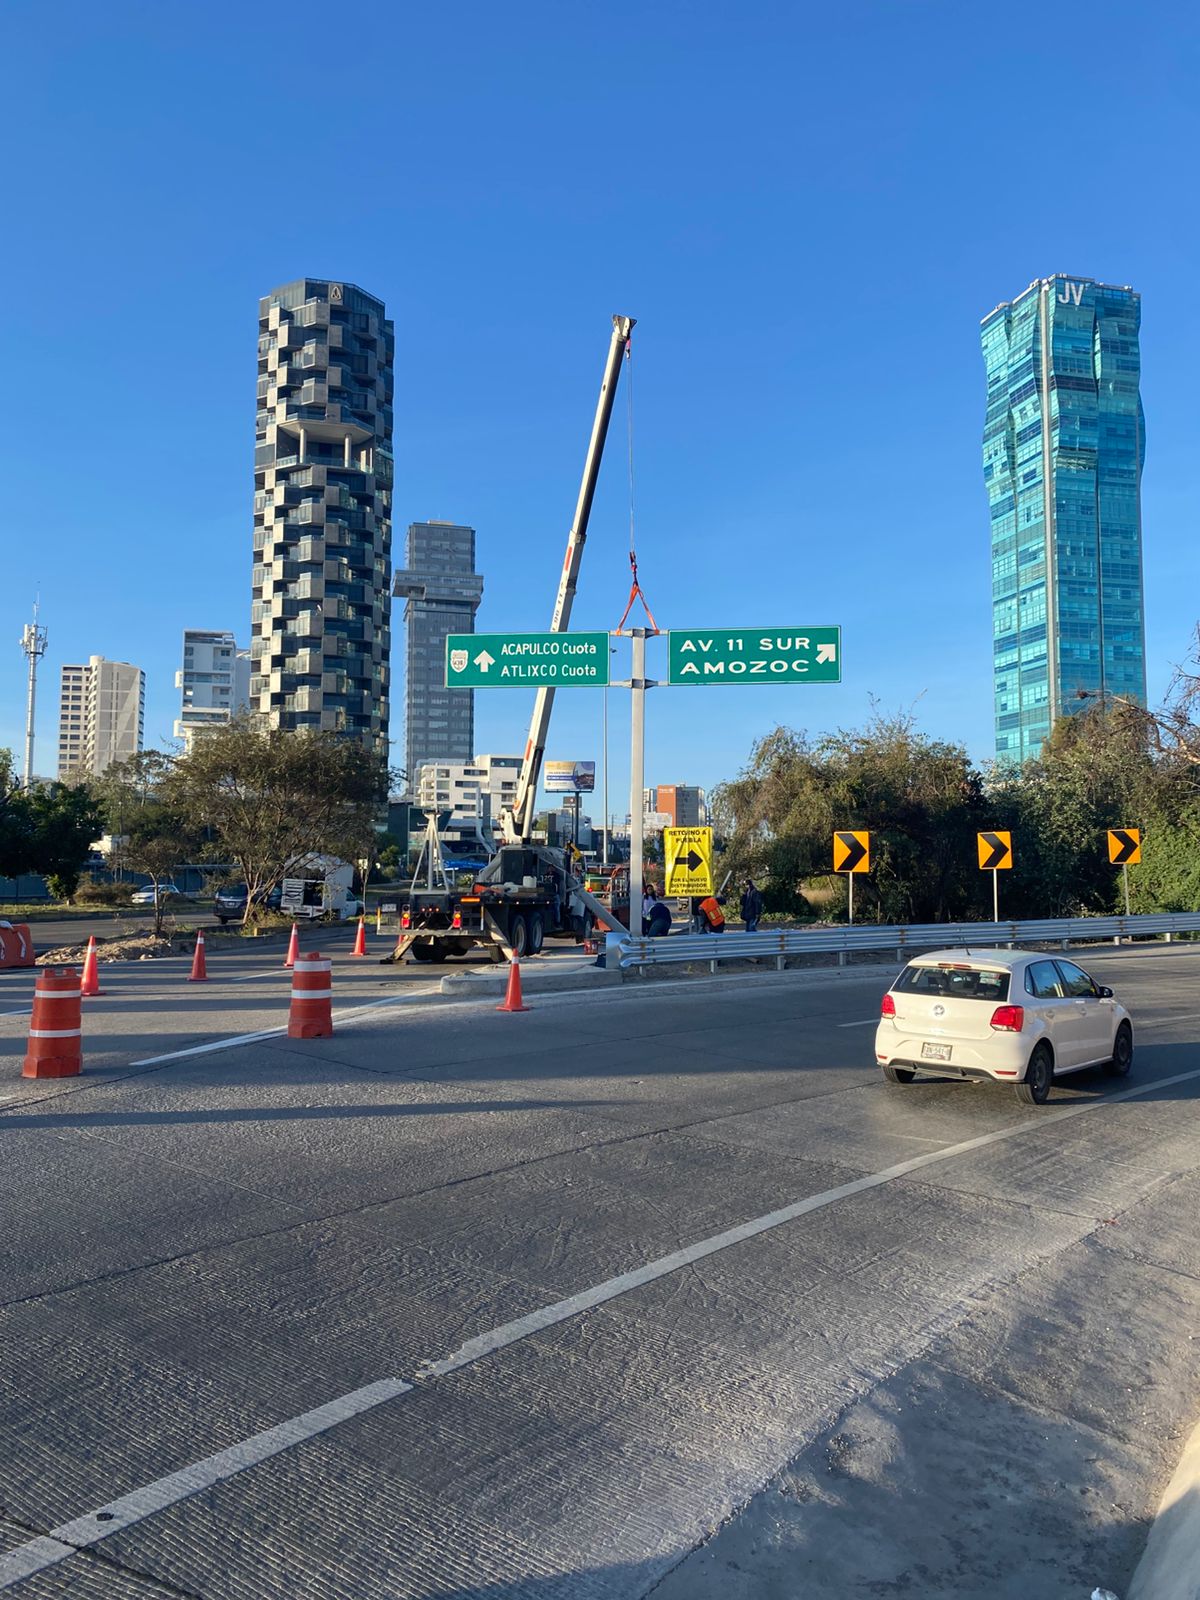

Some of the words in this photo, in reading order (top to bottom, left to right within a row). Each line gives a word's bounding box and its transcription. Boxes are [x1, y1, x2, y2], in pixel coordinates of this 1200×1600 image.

[1058, 282, 1084, 306] JV
[501, 642, 560, 656] ACAPULCO
[562, 642, 597, 654] Cuota
[680, 639, 719, 652] AV.
[727, 638, 743, 651] 11
[759, 637, 810, 651] SUR
[500, 664, 557, 677] ATLIXCO
[562, 664, 597, 676] Cuota
[680, 659, 810, 675] AMOZOC
